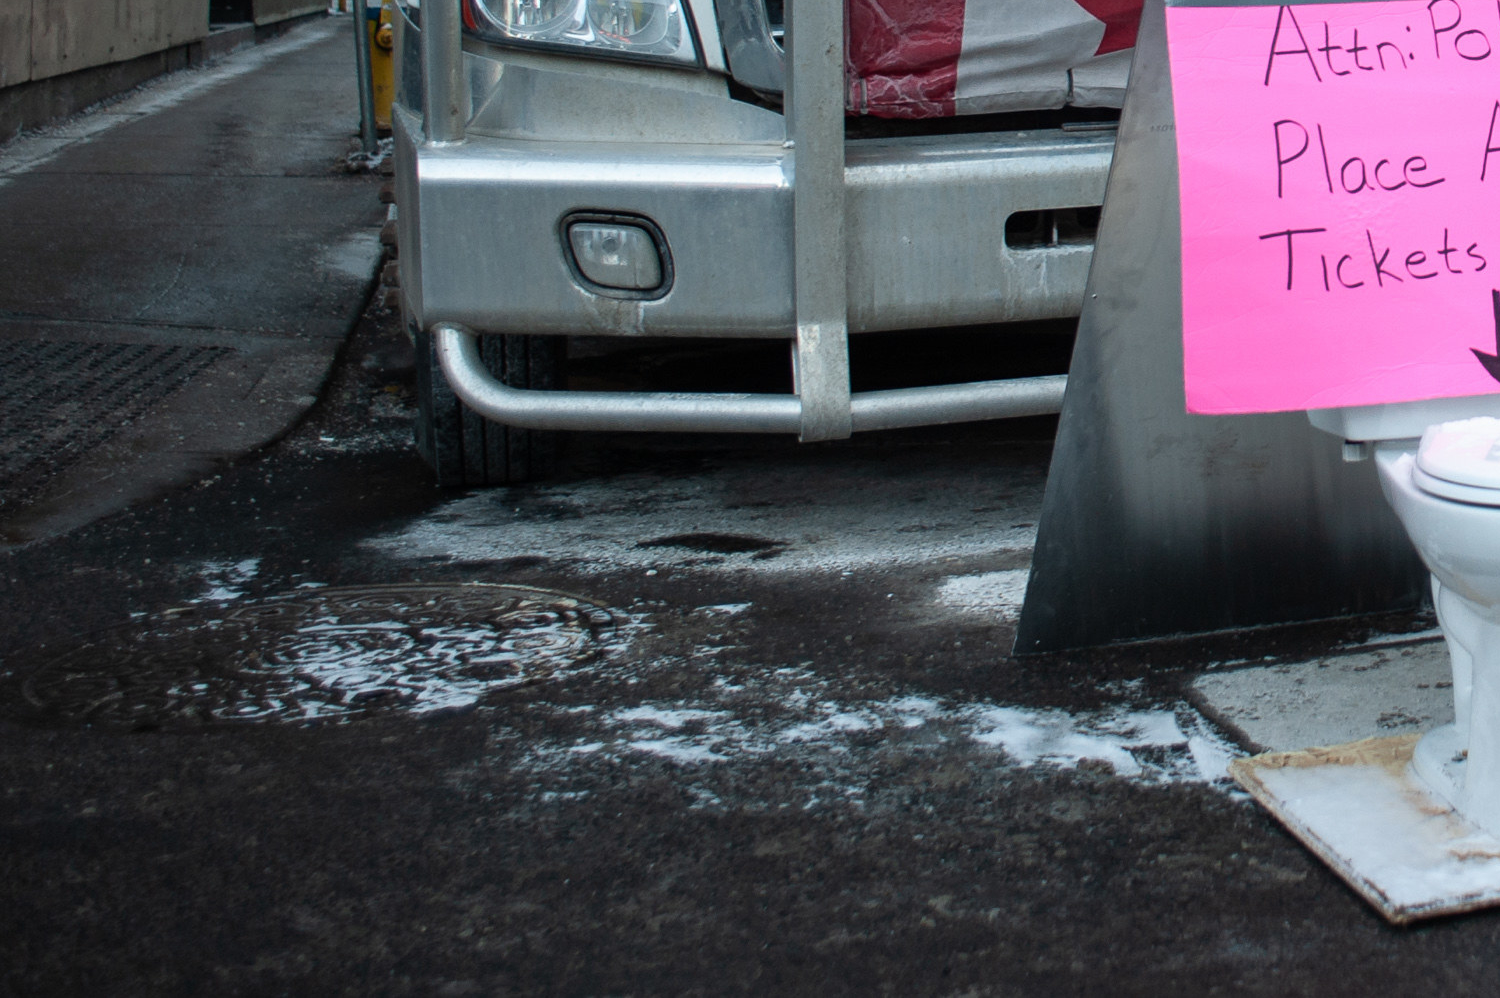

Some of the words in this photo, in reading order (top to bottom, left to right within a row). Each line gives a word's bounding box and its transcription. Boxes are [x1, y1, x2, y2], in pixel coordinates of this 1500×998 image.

[1264, 5, 1415, 86] Attn:
[1274, 119, 1445, 198] Place
[1259, 228, 1487, 291] Tickets
